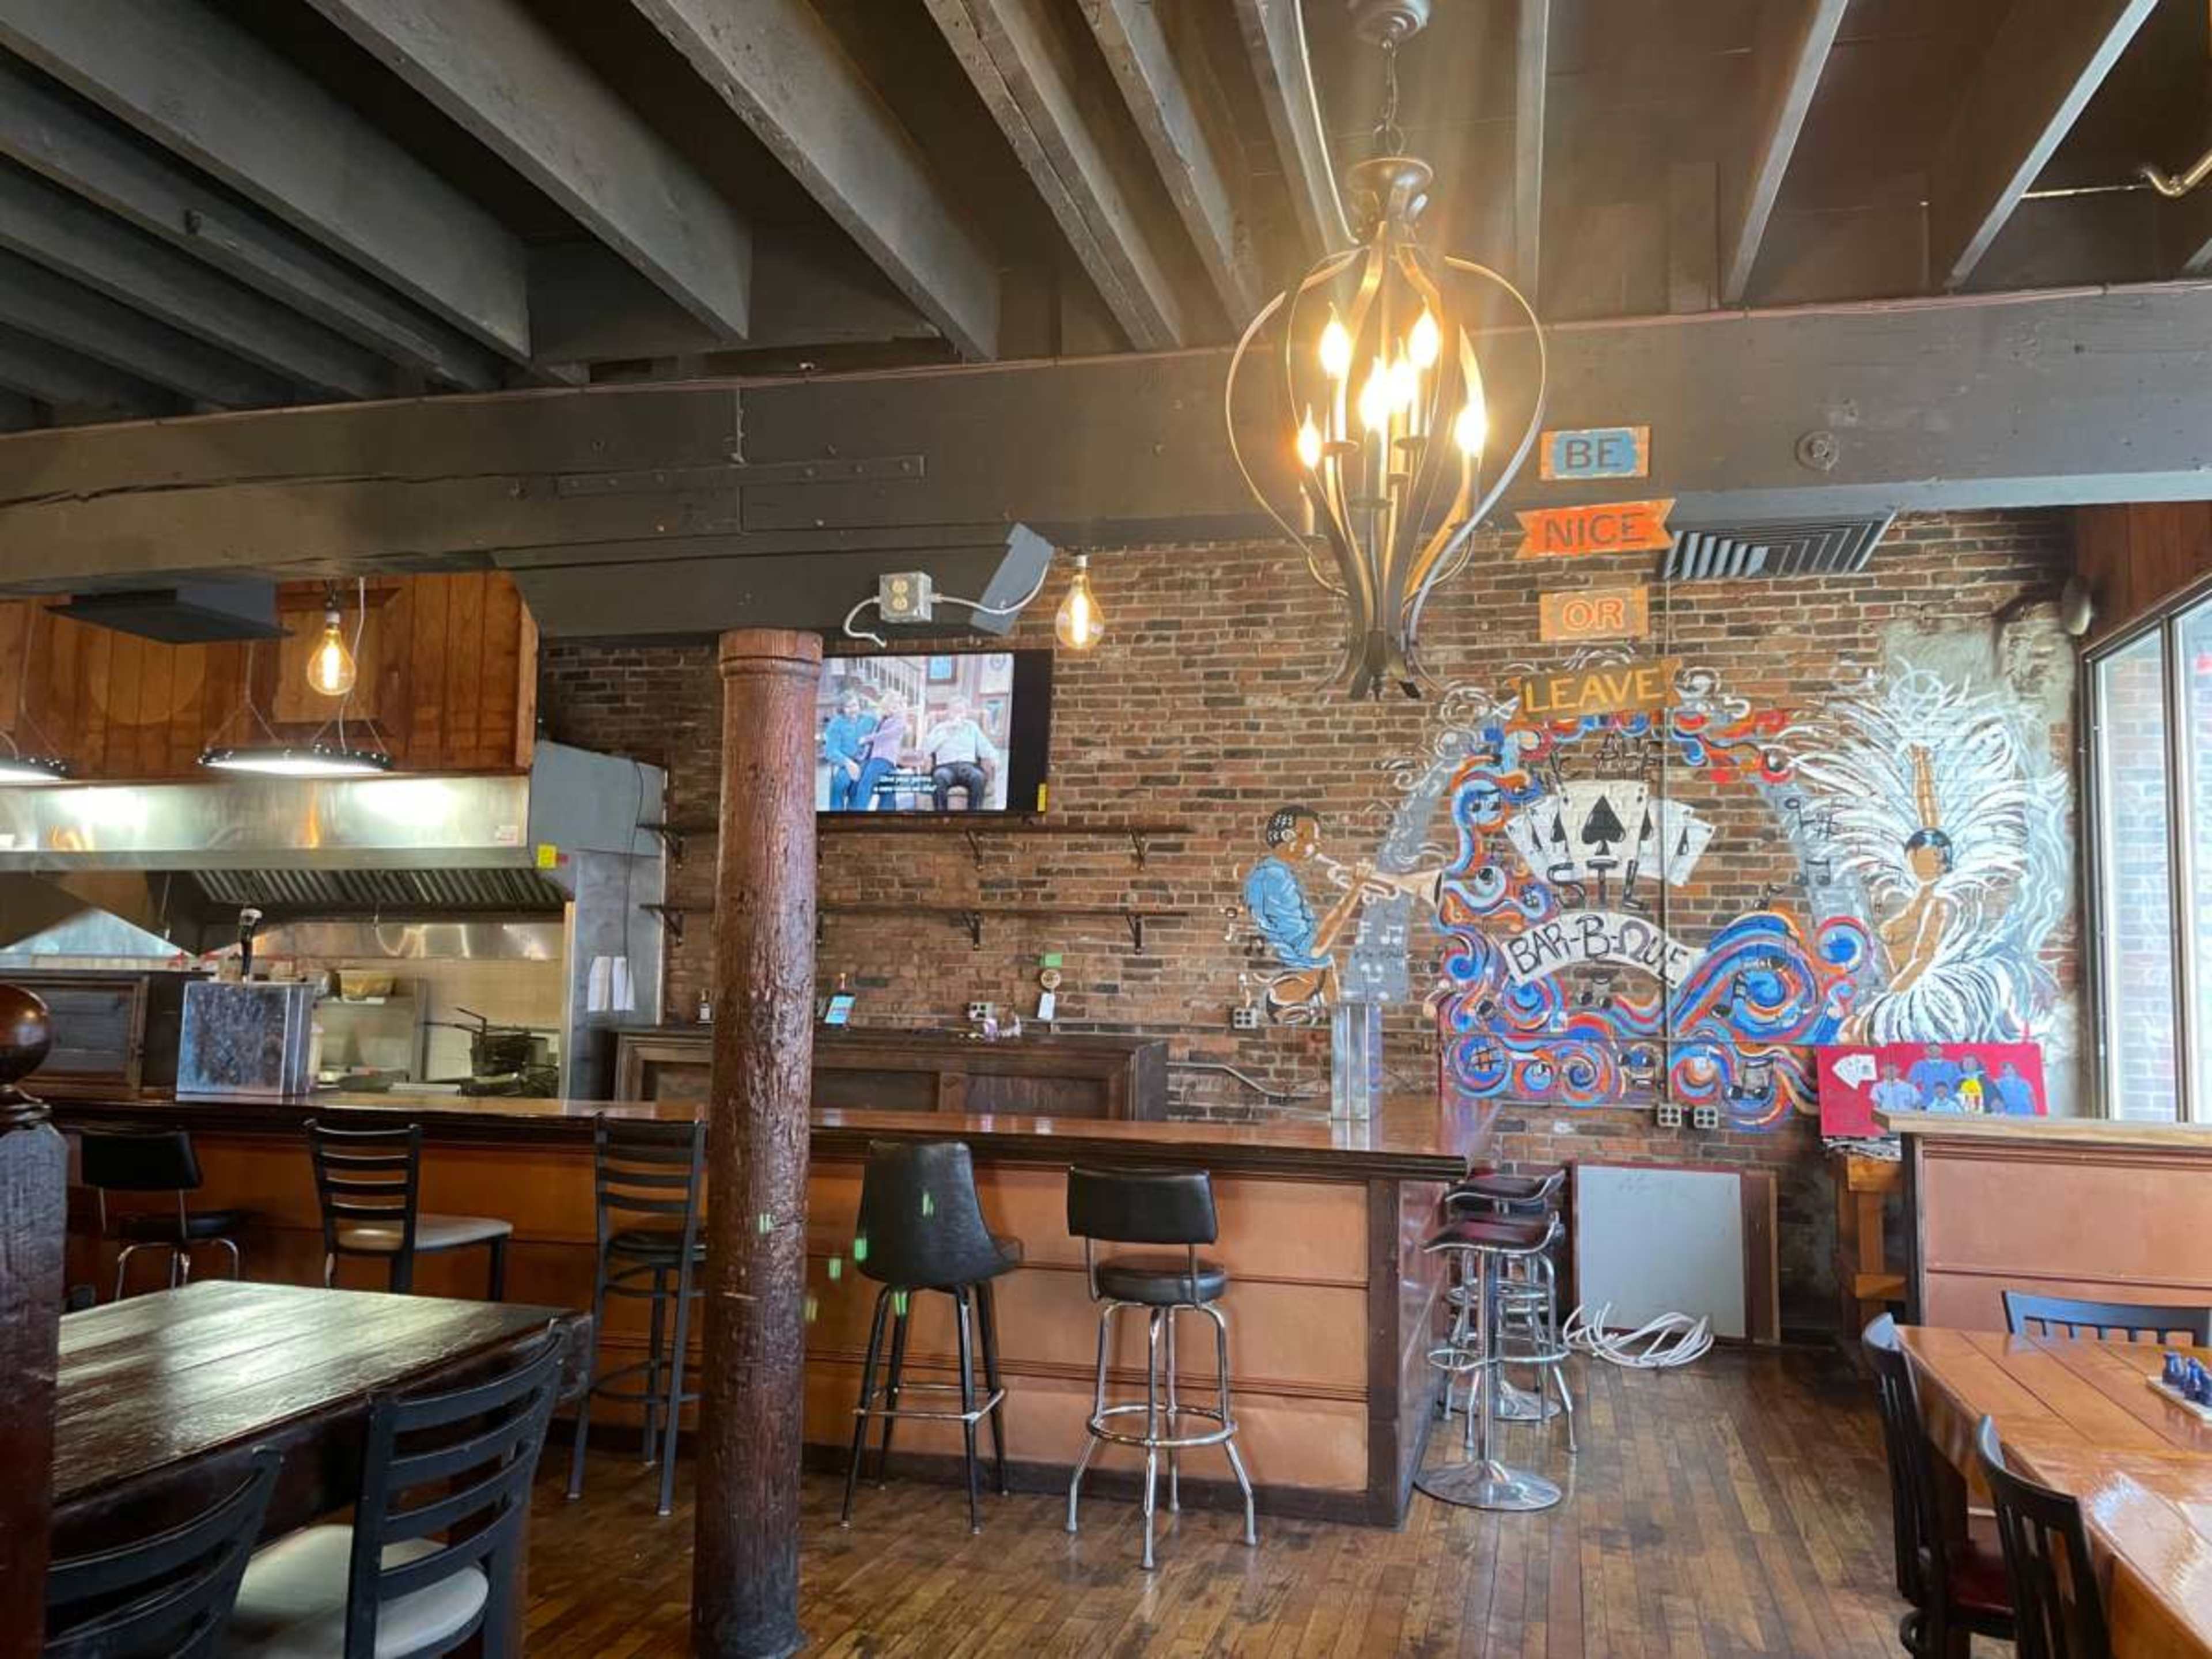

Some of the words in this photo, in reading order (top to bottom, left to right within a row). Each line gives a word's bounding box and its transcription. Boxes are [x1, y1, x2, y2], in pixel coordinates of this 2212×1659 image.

[1566, 438, 1624, 469] BE
[1545, 512, 1647, 550] NICE
[1562, 597, 1625, 631] OR
[1525, 667, 1666, 713] LEAVE
[1546, 859, 1649, 911] STL
